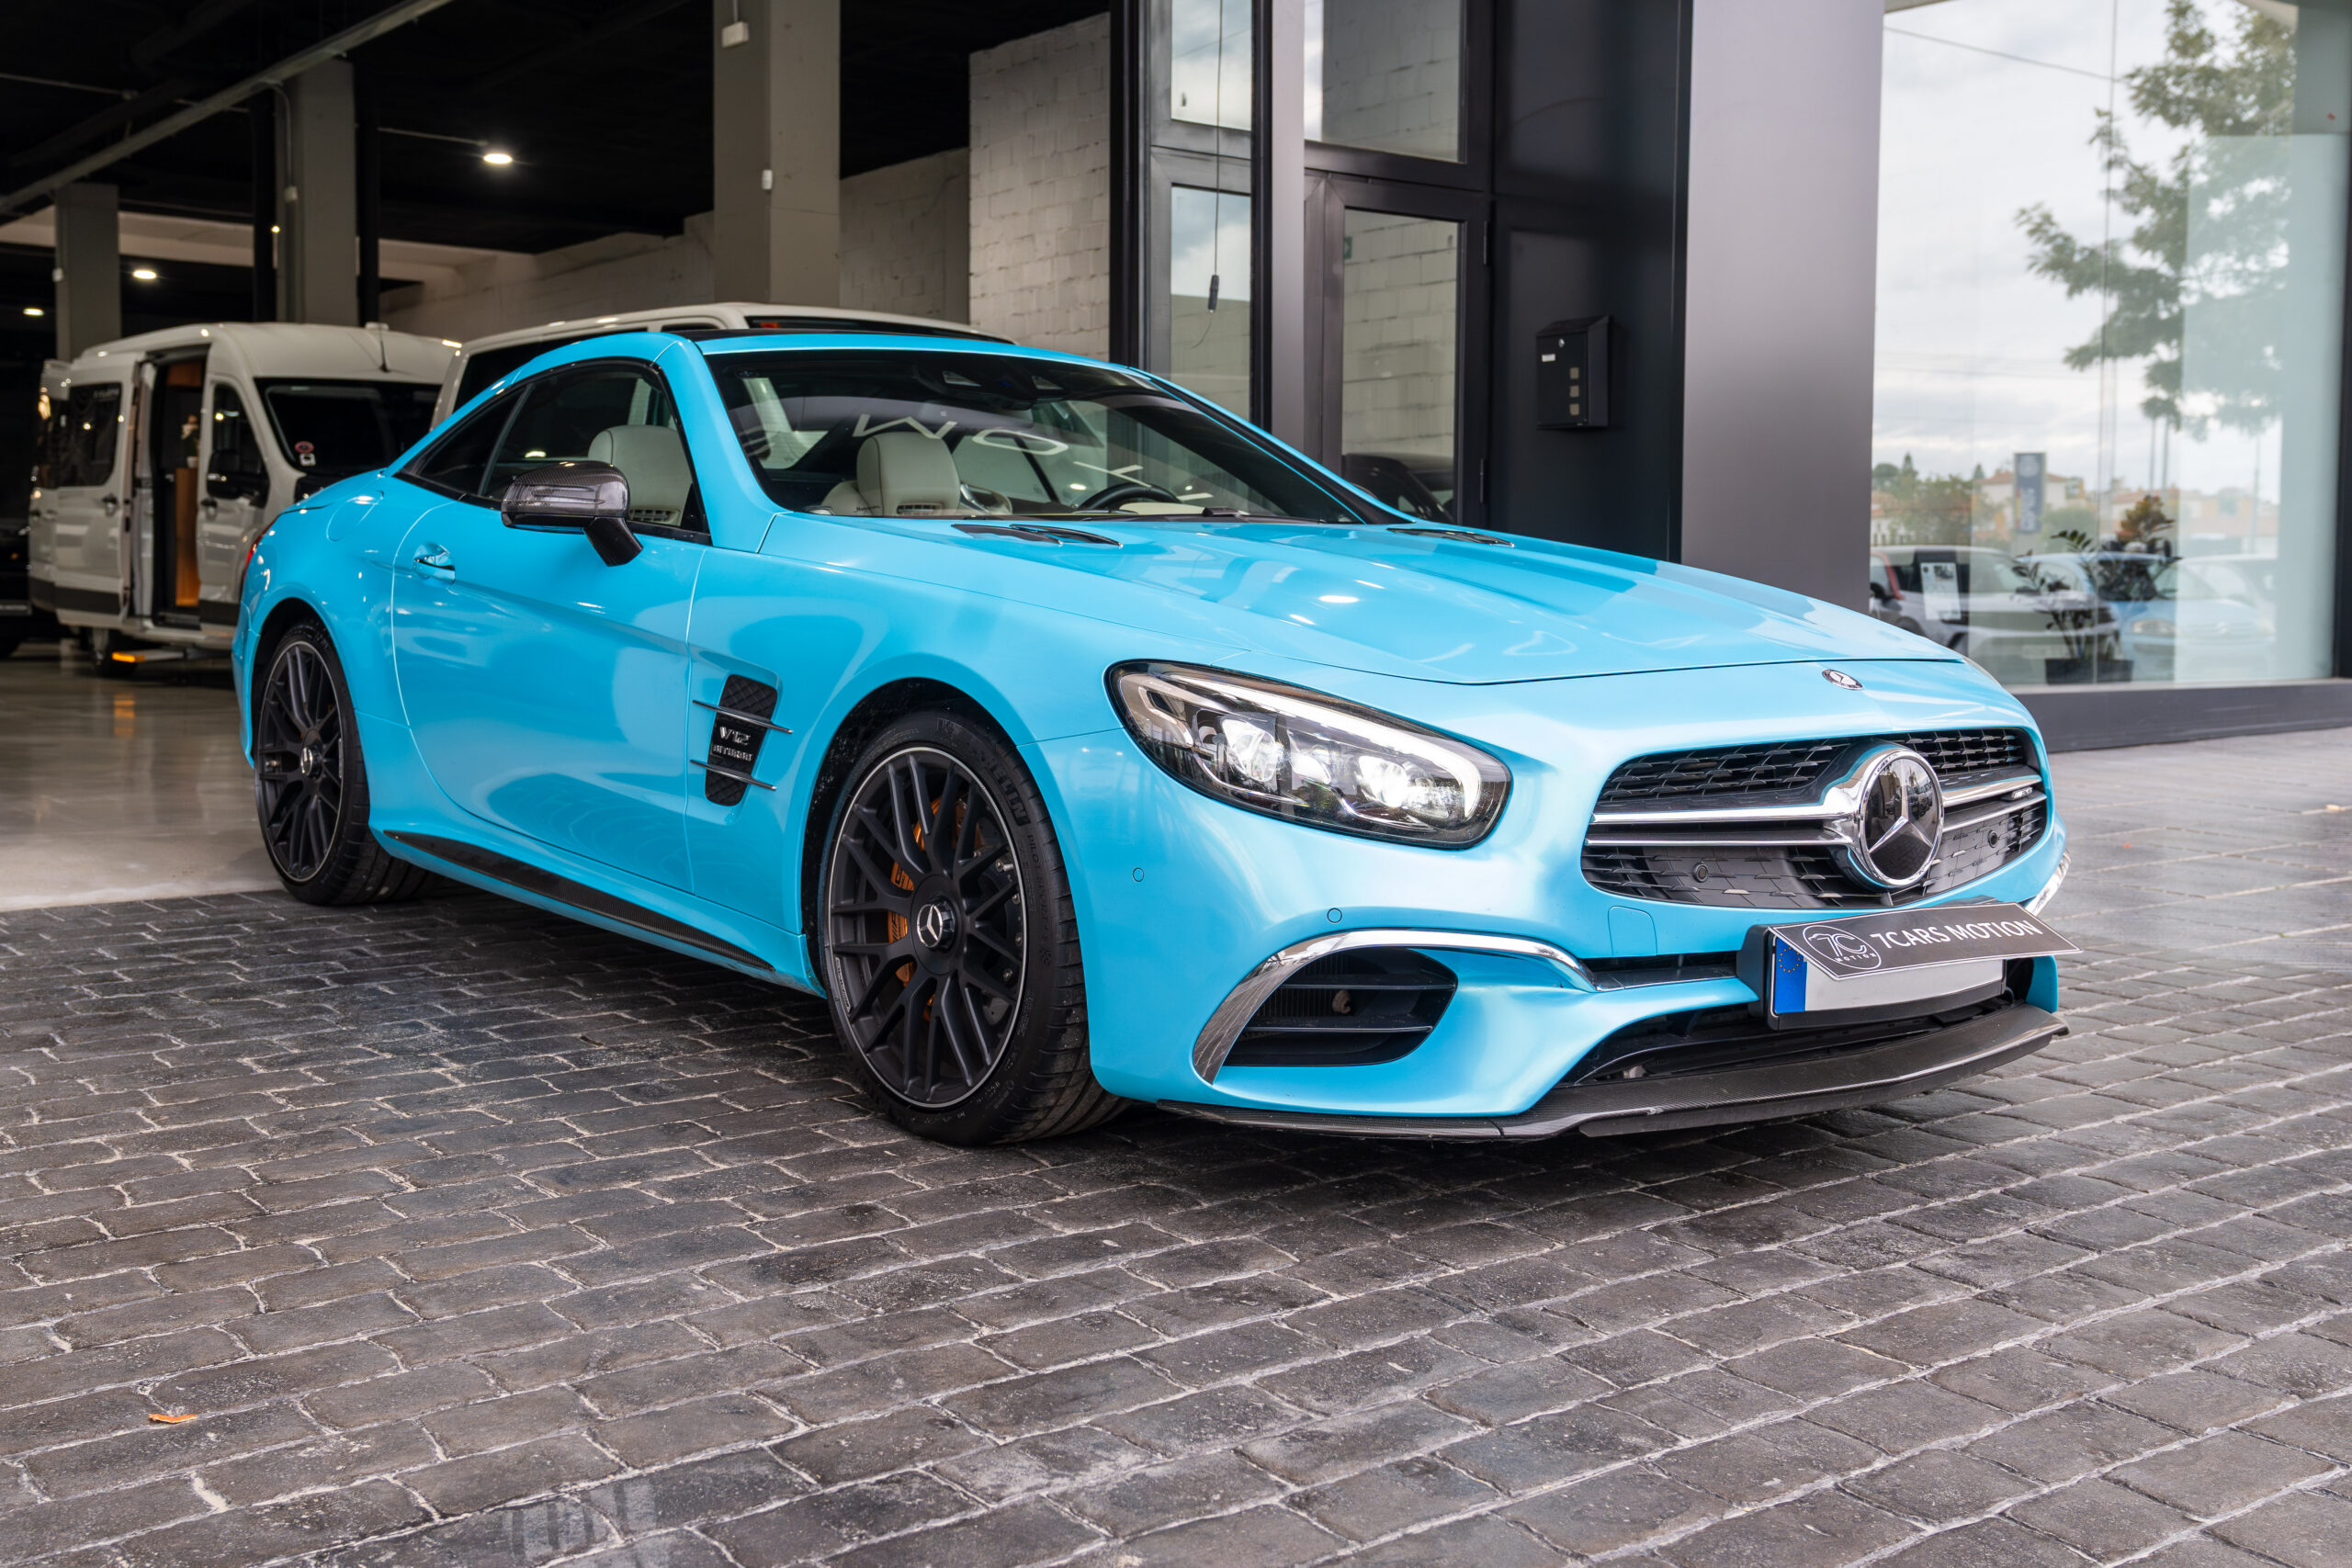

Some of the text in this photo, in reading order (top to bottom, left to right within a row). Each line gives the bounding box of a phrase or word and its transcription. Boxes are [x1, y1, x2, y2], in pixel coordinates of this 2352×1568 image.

[1870, 919, 2044, 950] 7CARS MOTION
[1835, 952, 1878, 964] MOTION
